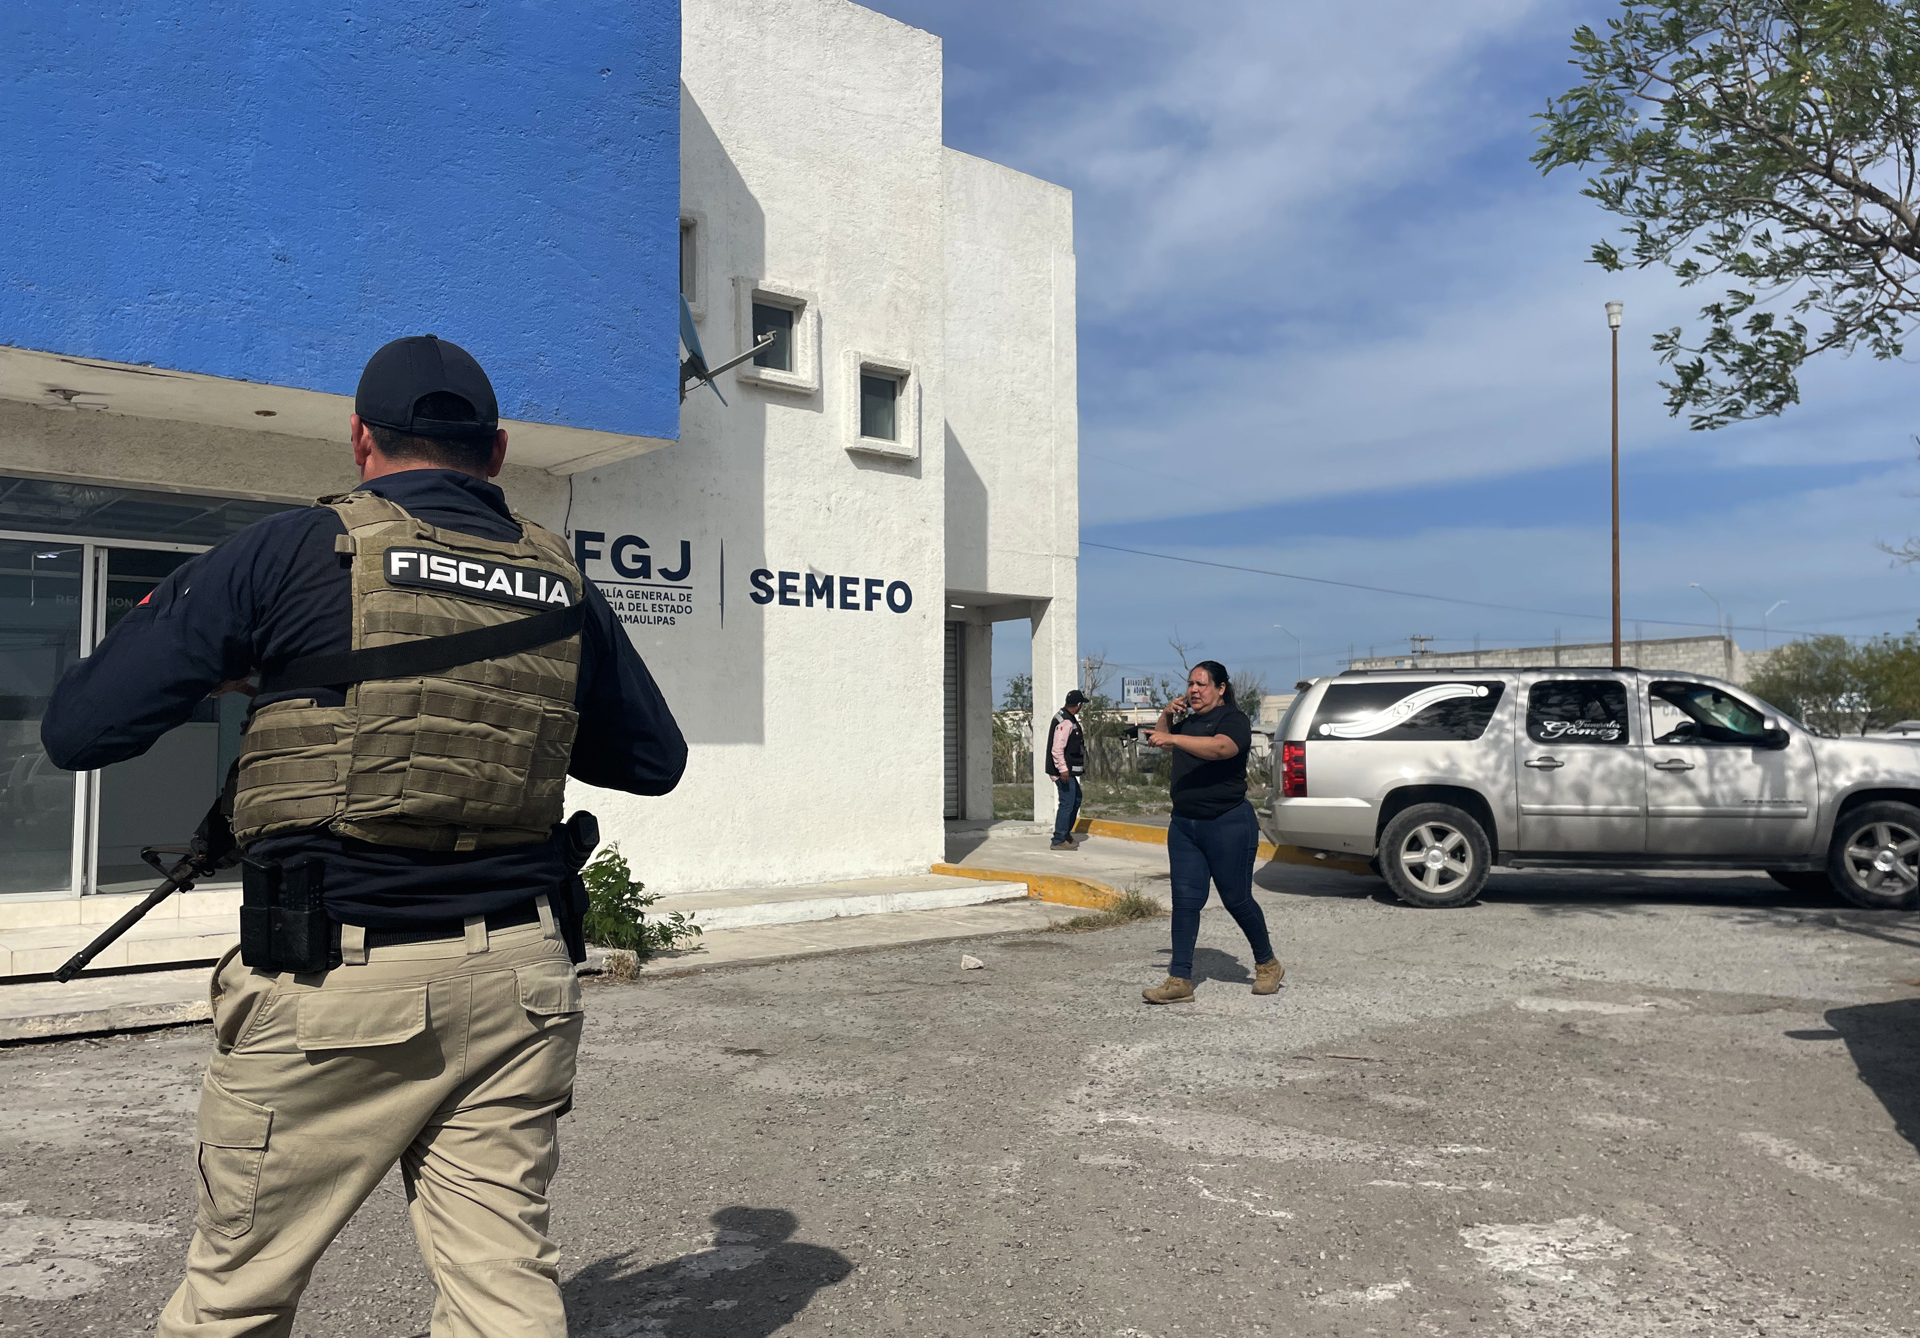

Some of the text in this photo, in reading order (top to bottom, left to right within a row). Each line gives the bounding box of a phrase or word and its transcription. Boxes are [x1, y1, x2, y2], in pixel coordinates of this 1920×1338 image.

[575, 530, 692, 582] FGJ
[390, 552, 571, 608] FISCALIA
[600, 587, 693, 603] ALÍA GENERAL DE
[749, 568, 913, 614] SEMEFO
[616, 614, 676, 626] AMAULIPAS
[628, 603, 648, 613] DEL
[651, 604, 693, 615] ESTADO
